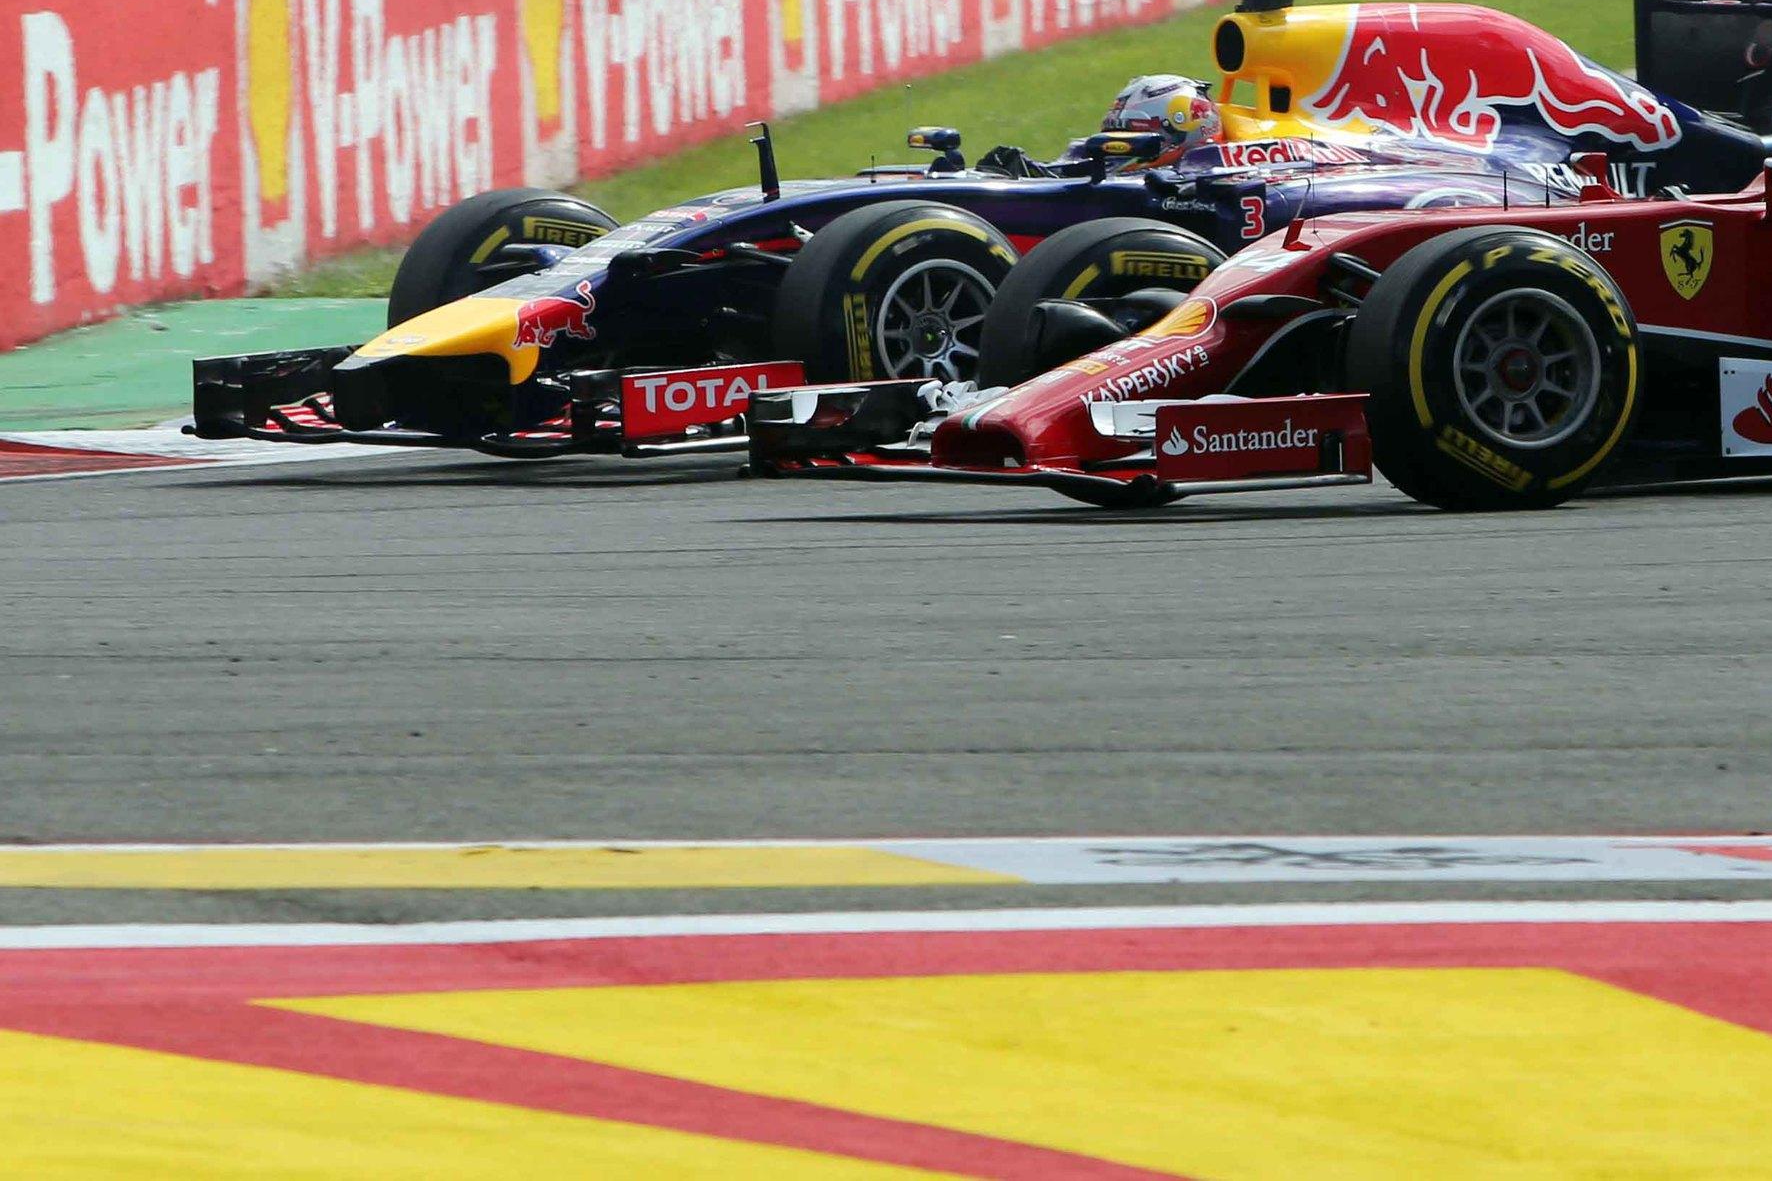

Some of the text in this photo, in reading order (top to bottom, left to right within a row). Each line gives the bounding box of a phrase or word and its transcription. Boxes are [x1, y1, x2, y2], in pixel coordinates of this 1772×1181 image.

[0, 10, 221, 305] -Power
[1219, 138, 1292, 167] Red
[1241, 196, 1264, 239] 3
[1079, 348, 1196, 412] KASPERSKY
[1192, 419, 1318, 456] Santander
